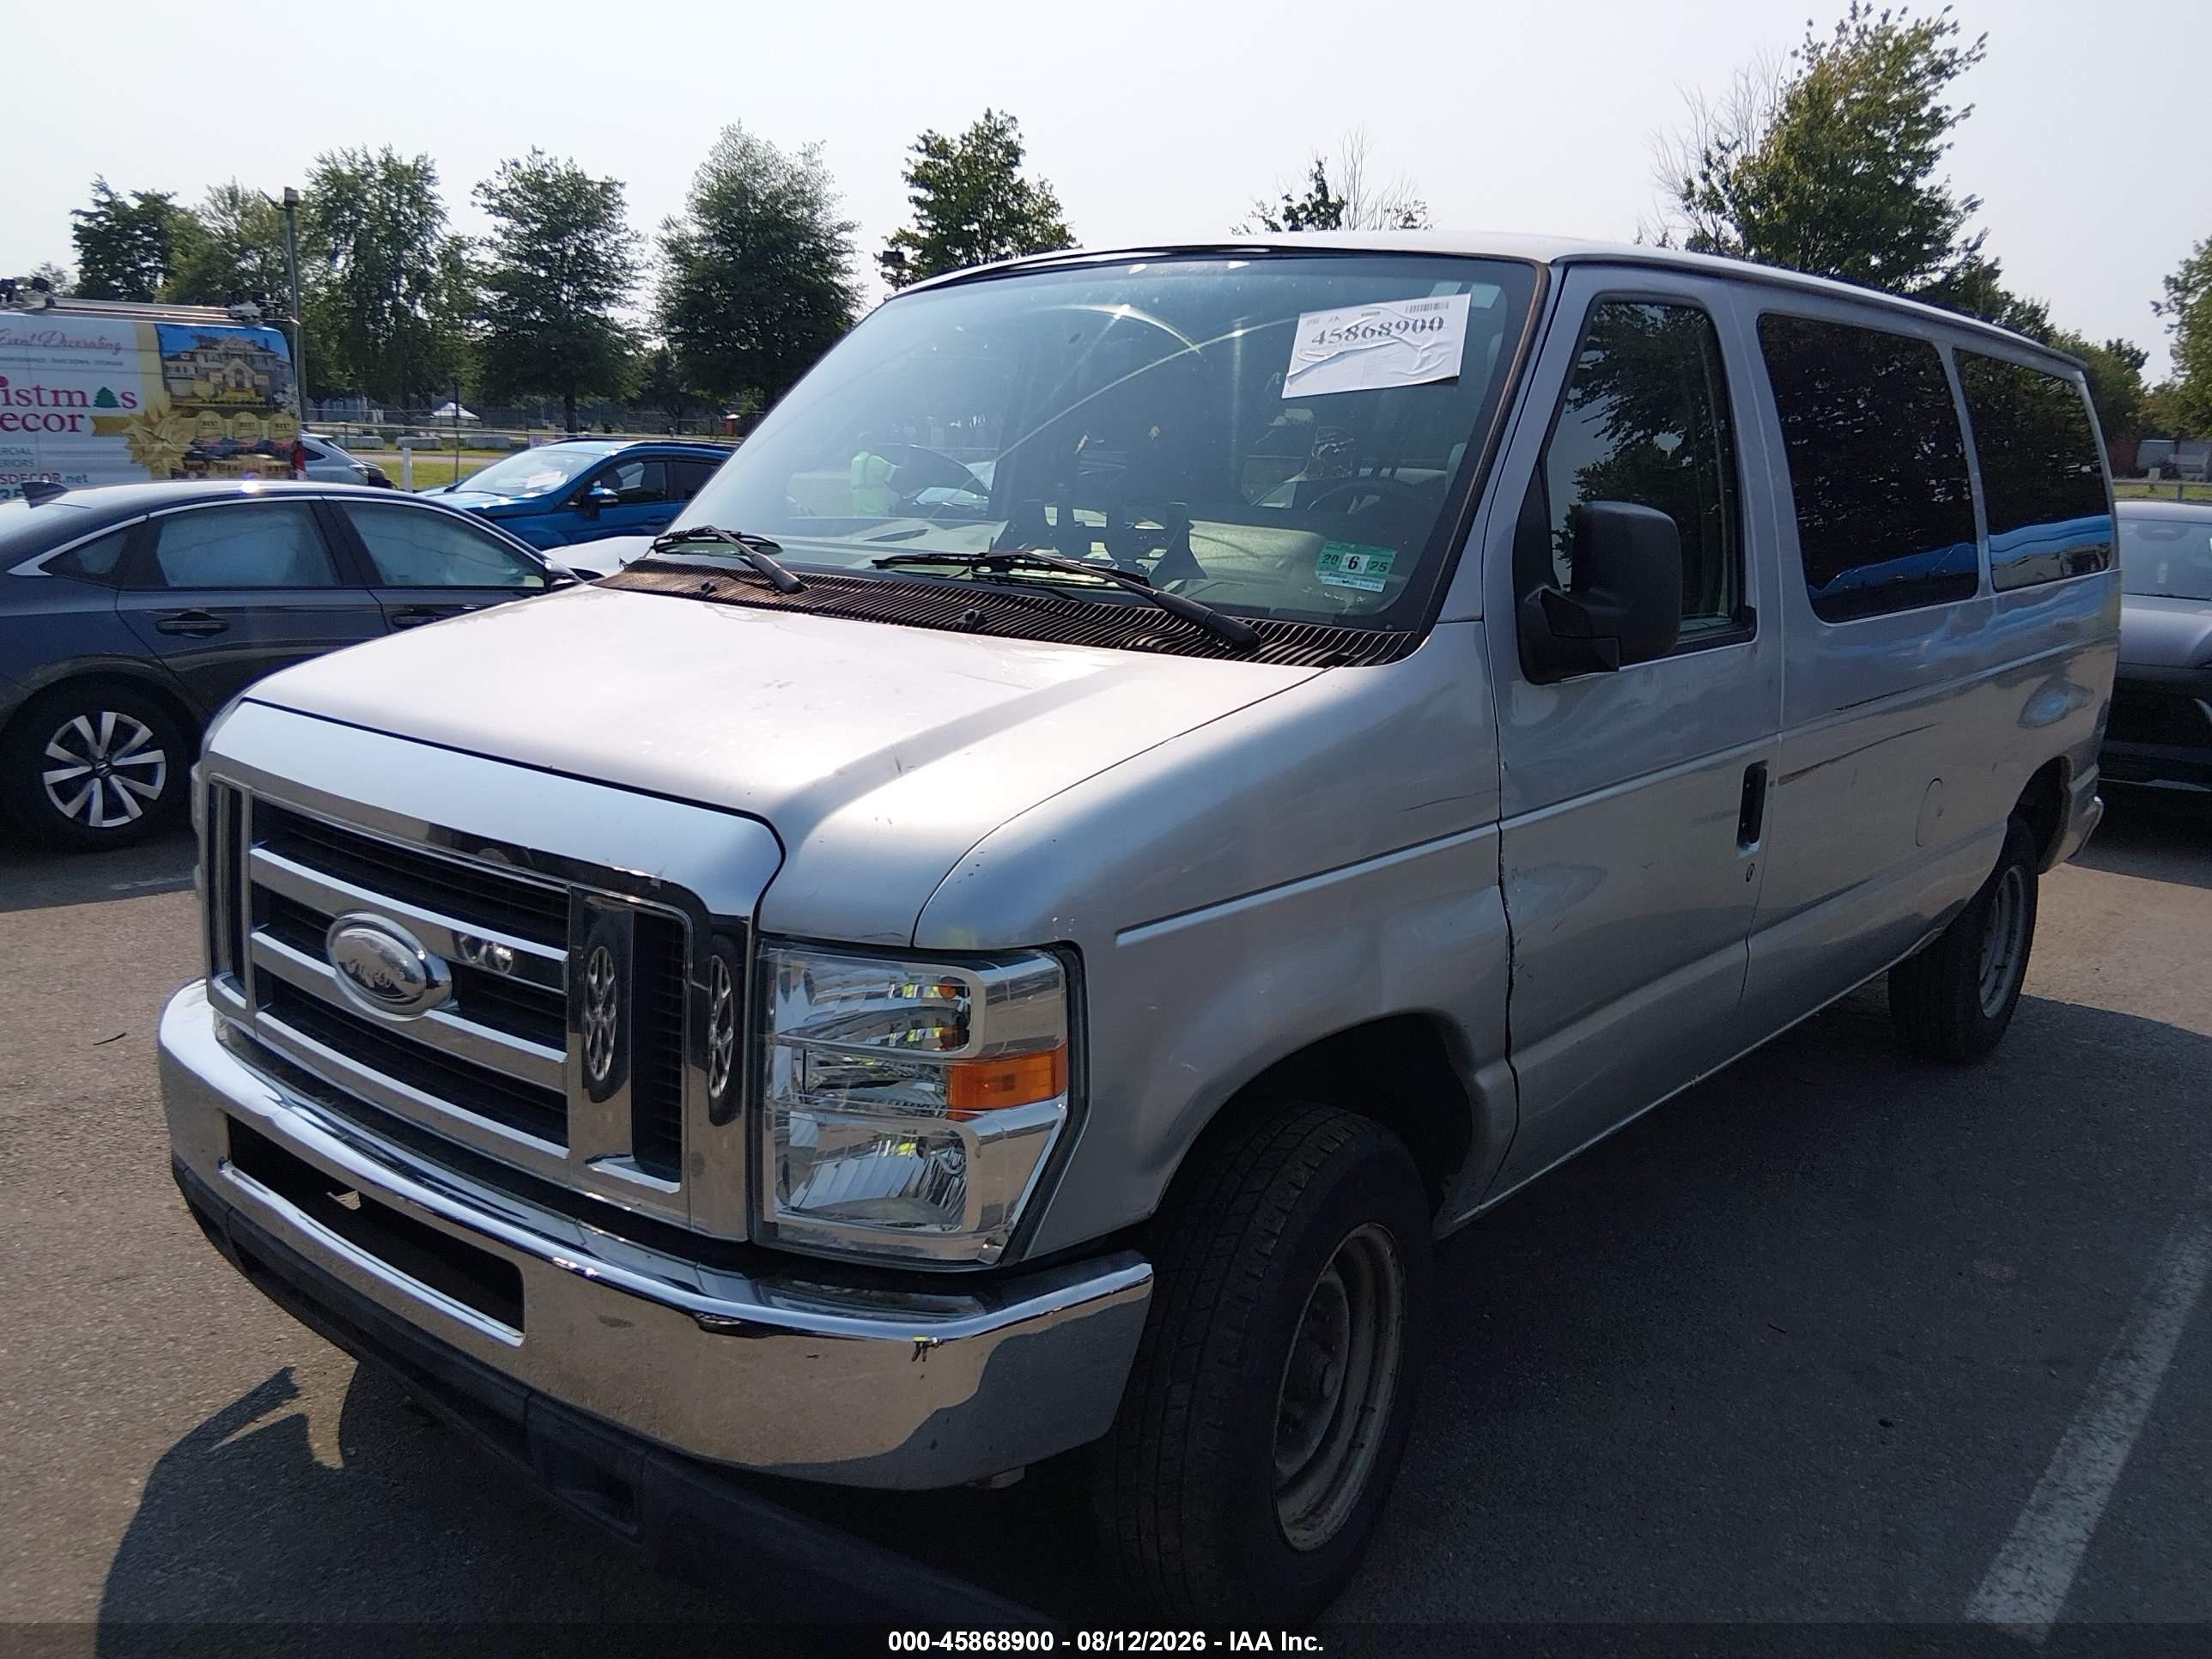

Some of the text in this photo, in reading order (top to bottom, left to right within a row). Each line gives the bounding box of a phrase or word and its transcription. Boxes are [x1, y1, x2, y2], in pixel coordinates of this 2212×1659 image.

[1311, 315, 1445, 345] 45868900
[0, 412, 85, 433] ecor
[1322, 554, 1389, 572] 20 6 25
